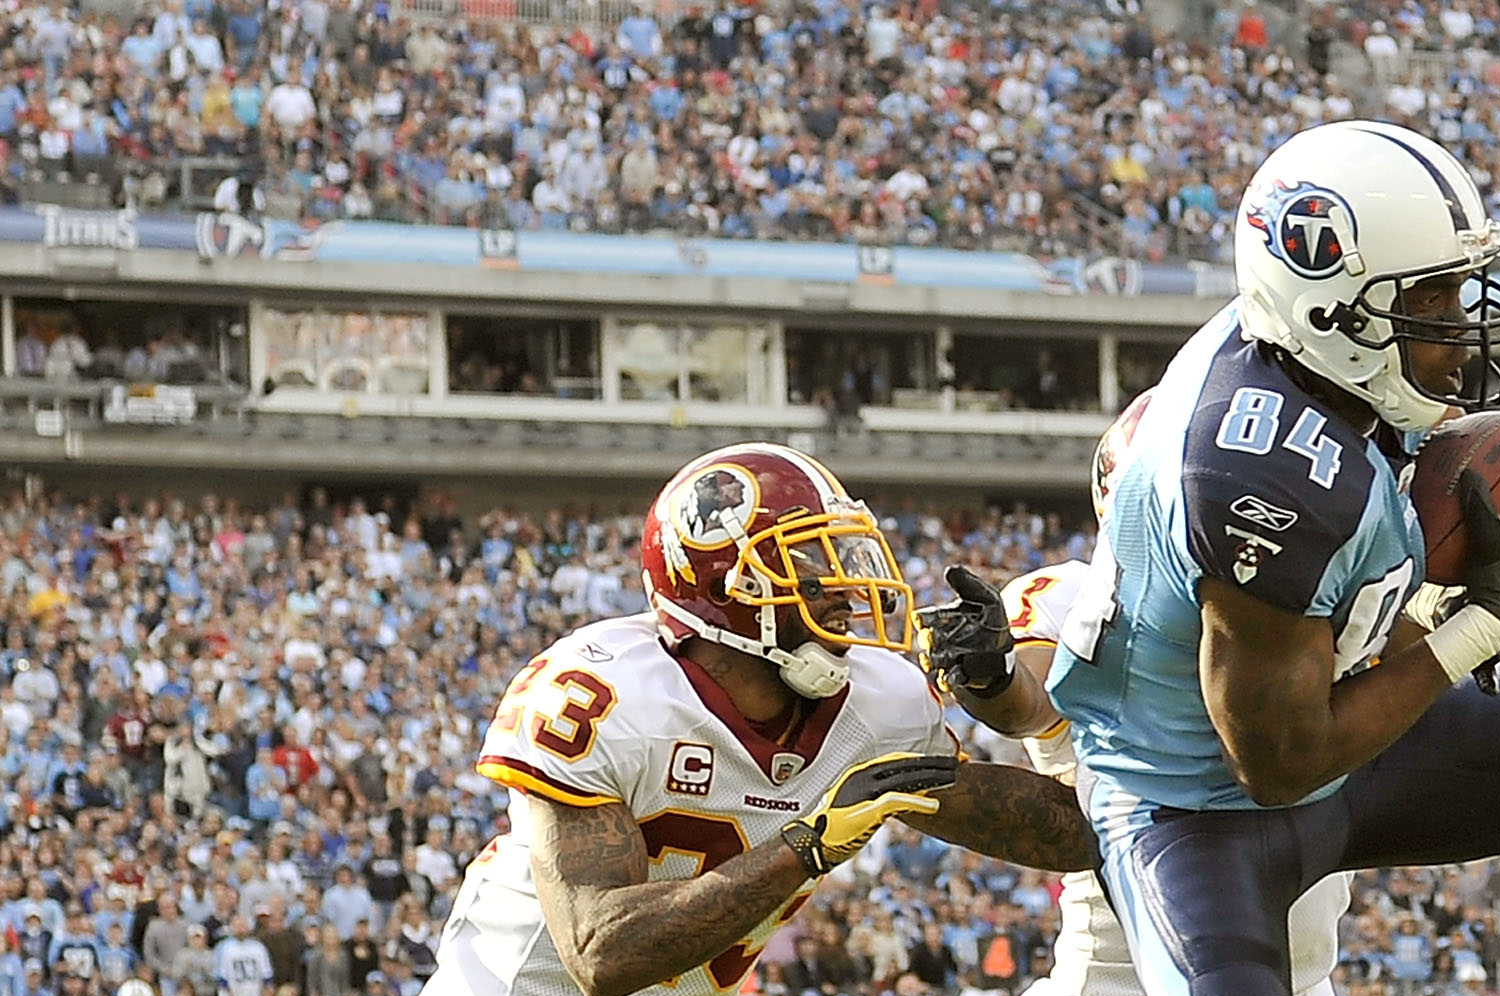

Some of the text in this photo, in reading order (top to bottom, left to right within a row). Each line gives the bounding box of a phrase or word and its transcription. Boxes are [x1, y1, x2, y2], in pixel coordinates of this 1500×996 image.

[1215, 386, 1344, 490] 84
[671, 745, 712, 784] C
[743, 795, 800, 813] REDSKINS
